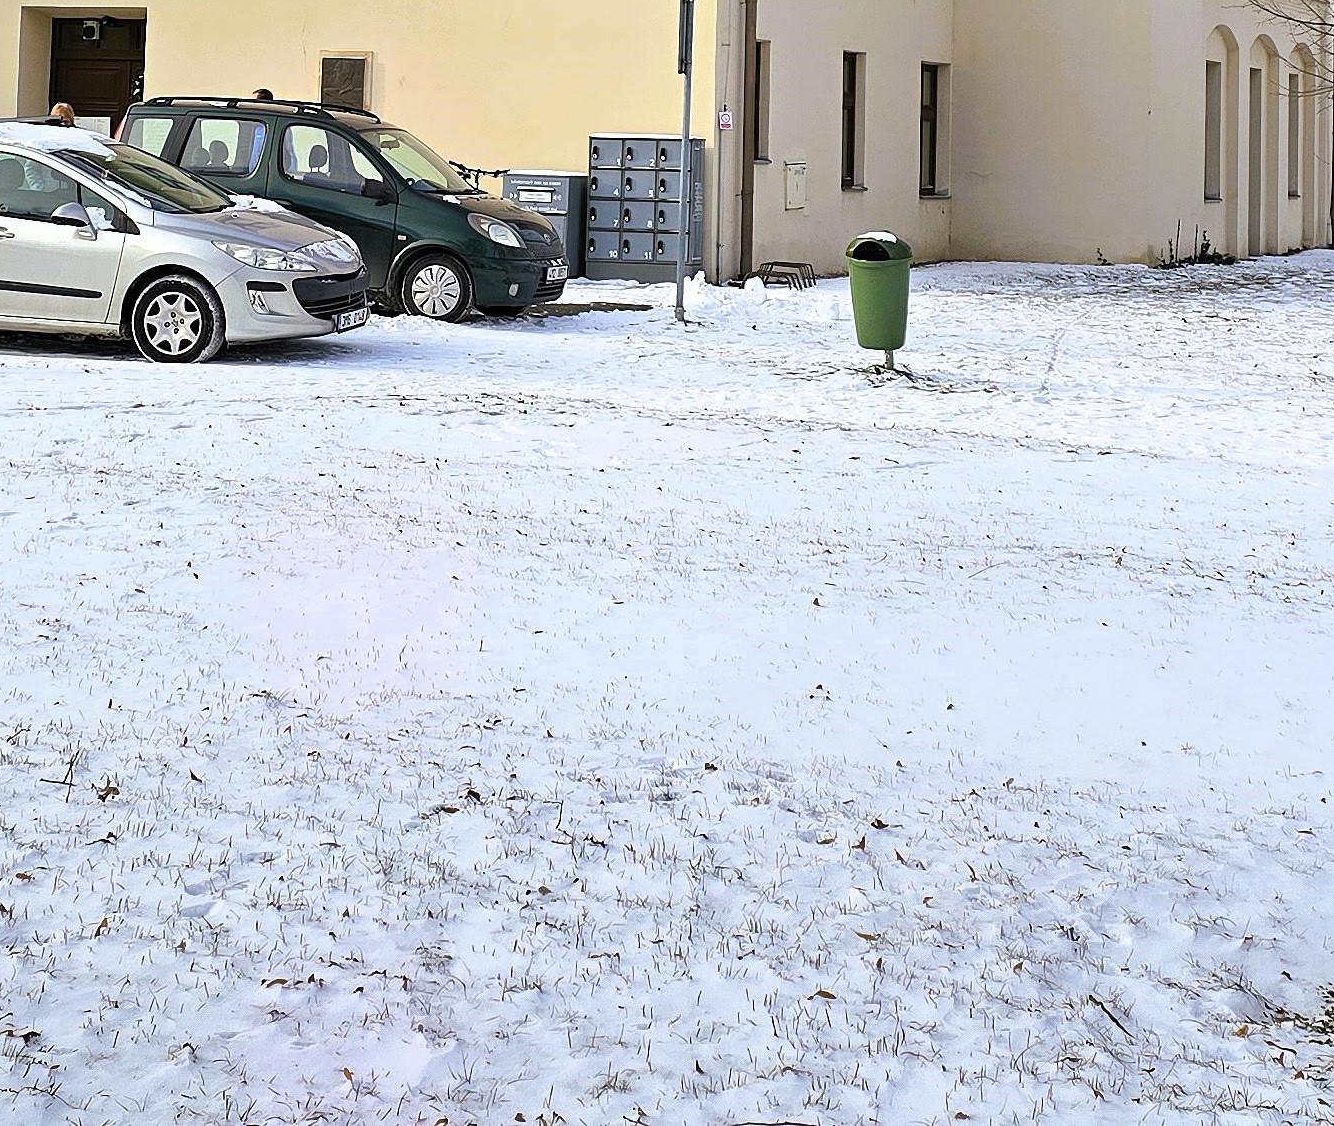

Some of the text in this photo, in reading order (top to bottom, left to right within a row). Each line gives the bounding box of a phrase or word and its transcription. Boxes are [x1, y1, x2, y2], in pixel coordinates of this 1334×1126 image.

[650, 159, 655, 167] 2
[613, 188, 619, 196] 4
[648, 189, 654, 197] 5
[613, 219, 619, 227] 7
[609, 250, 618, 259] 10
[644, 252, 653, 260] 11
